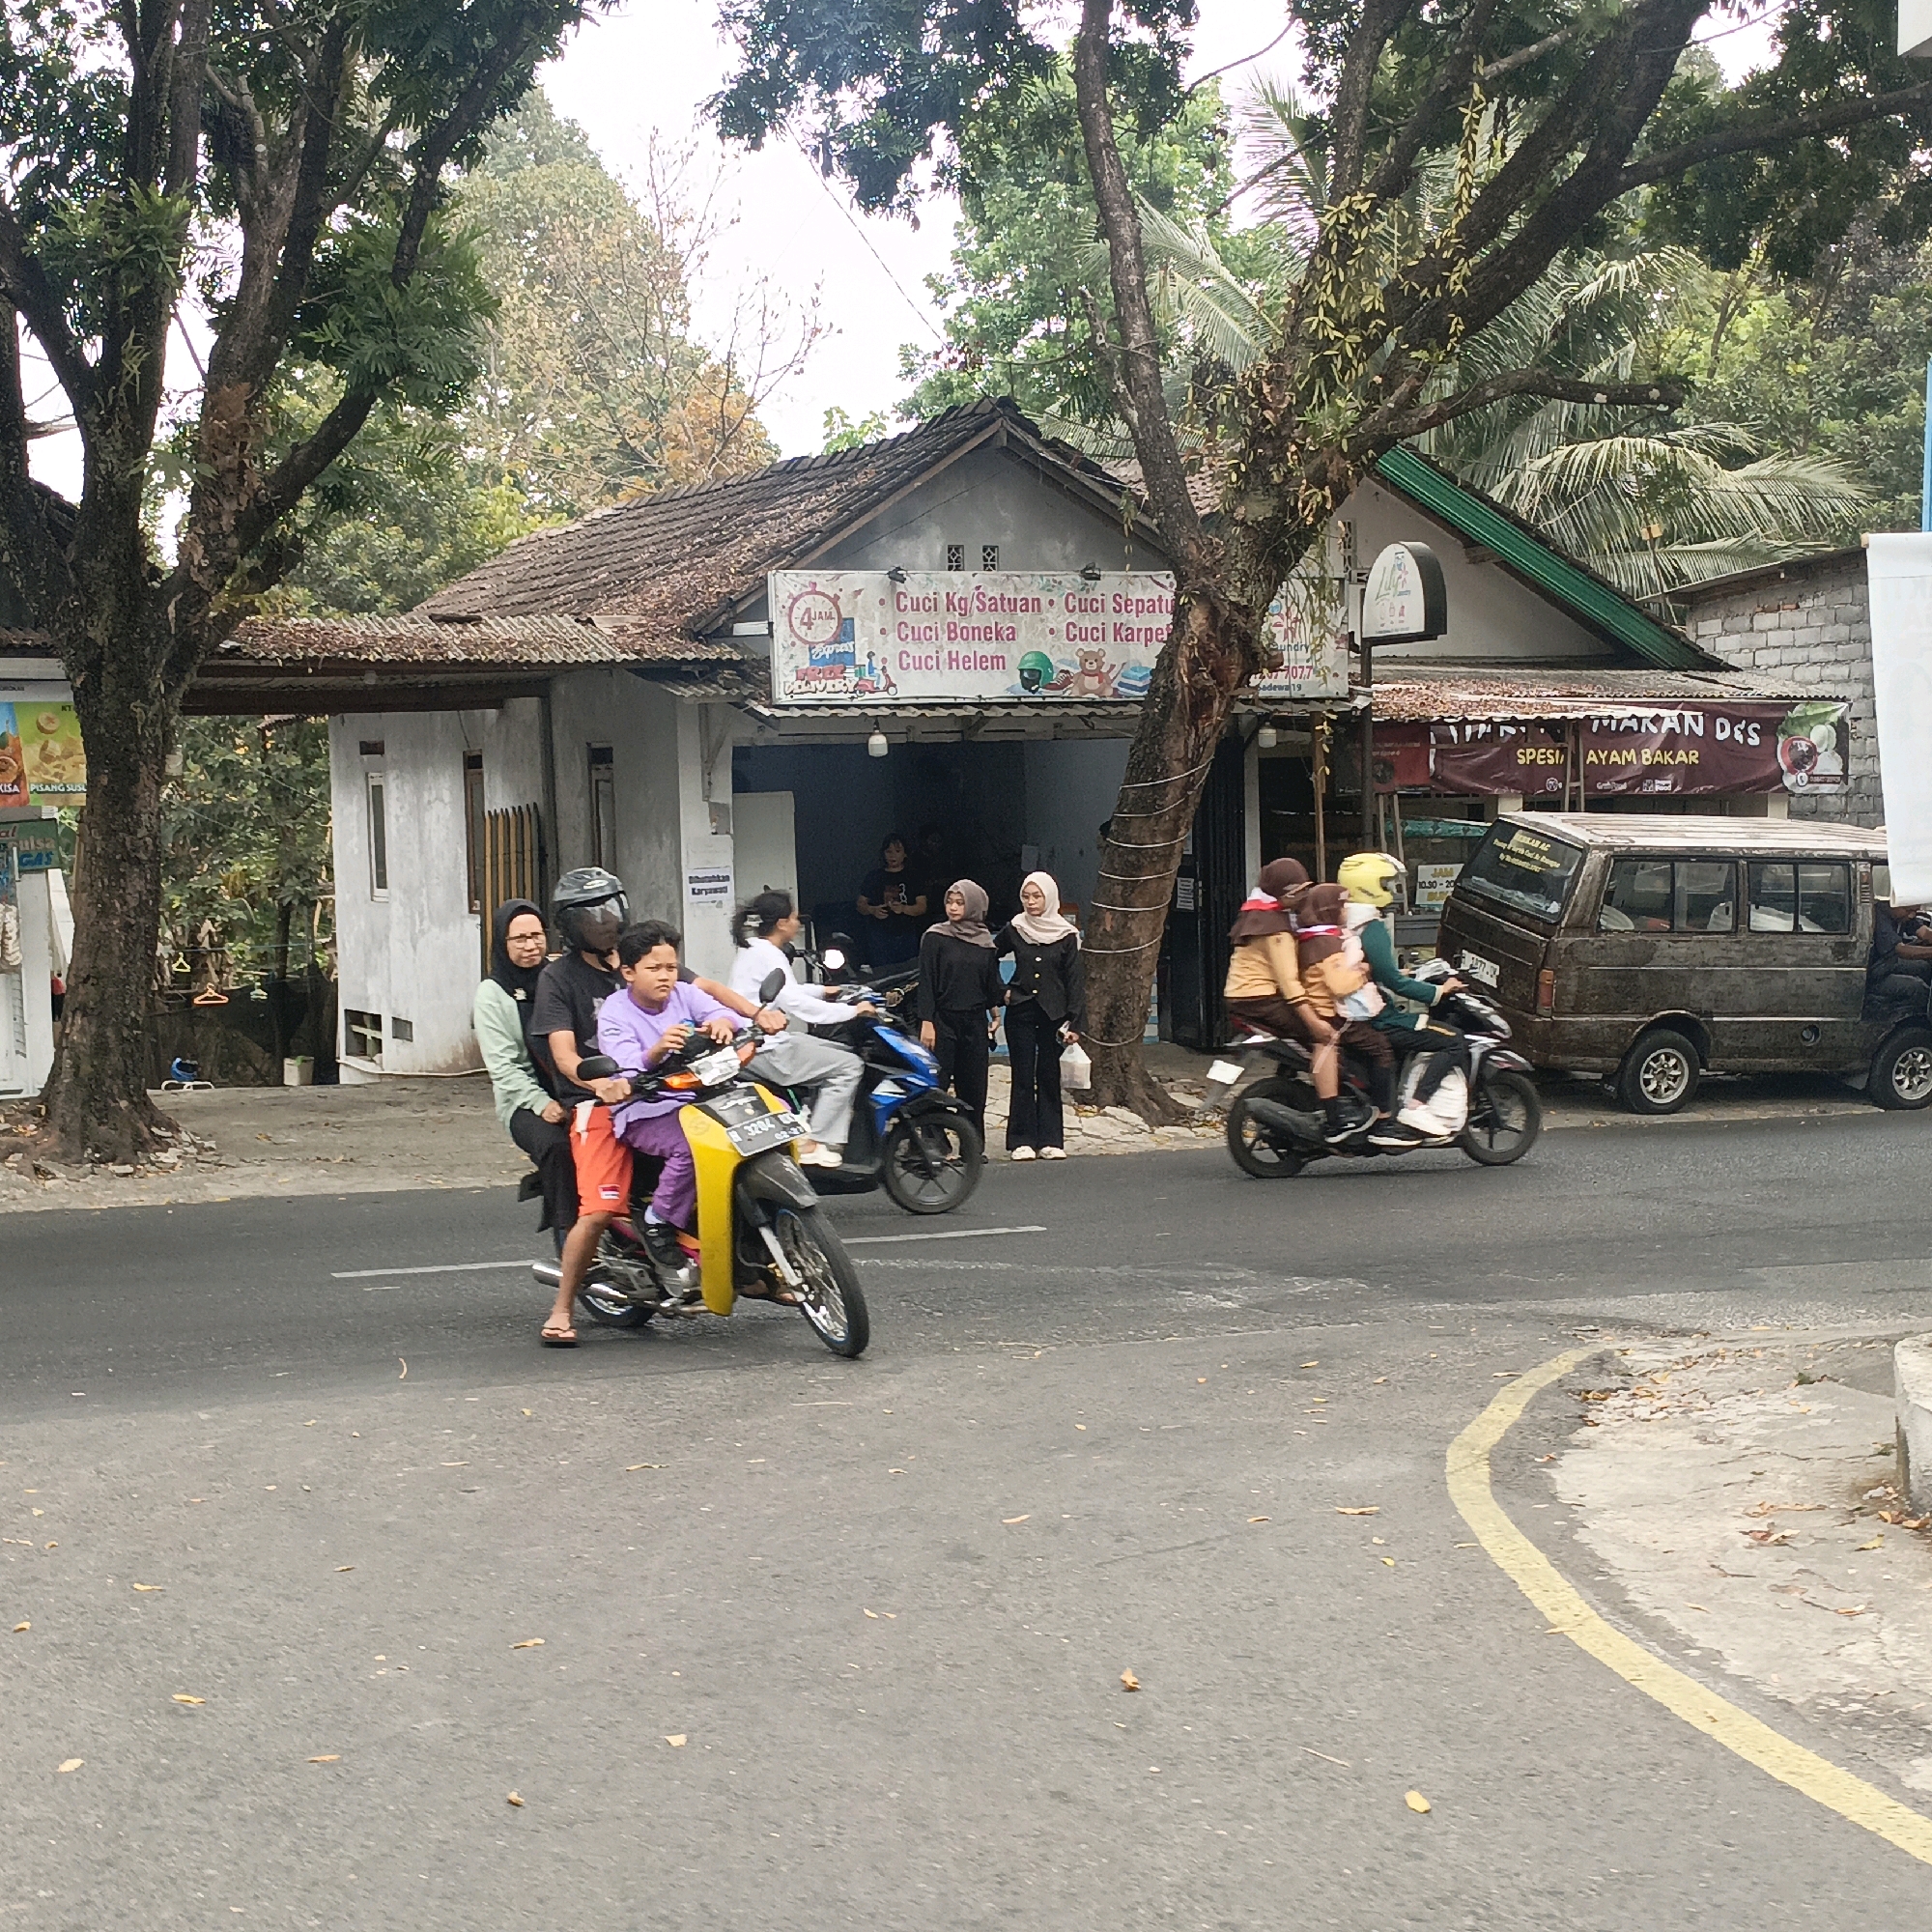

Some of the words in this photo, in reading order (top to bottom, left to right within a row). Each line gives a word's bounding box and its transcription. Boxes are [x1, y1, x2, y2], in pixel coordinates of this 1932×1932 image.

[895, 591, 938, 612] Cuci
[946, 585, 1041, 616] Kg/Satuan
[1065, 592, 1106, 613] Cuci
[1113, 593, 1176, 617] Sepatu
[800, 608, 814, 630] 4
[812, 611, 833, 620] JAM
[896, 621, 939, 641] Cuci
[947, 621, 1016, 641] Boneka
[1065, 621, 1106, 642] Cuci
[898, 650, 940, 670] Cuci
[948, 650, 1006, 670] Helem
[1518, 748, 1565, 765] SPESI
[1586, 750, 1636, 765] AYAM
[1641, 749, 1699, 765] BAKAR
[30, 783, 65, 792] PISANG
